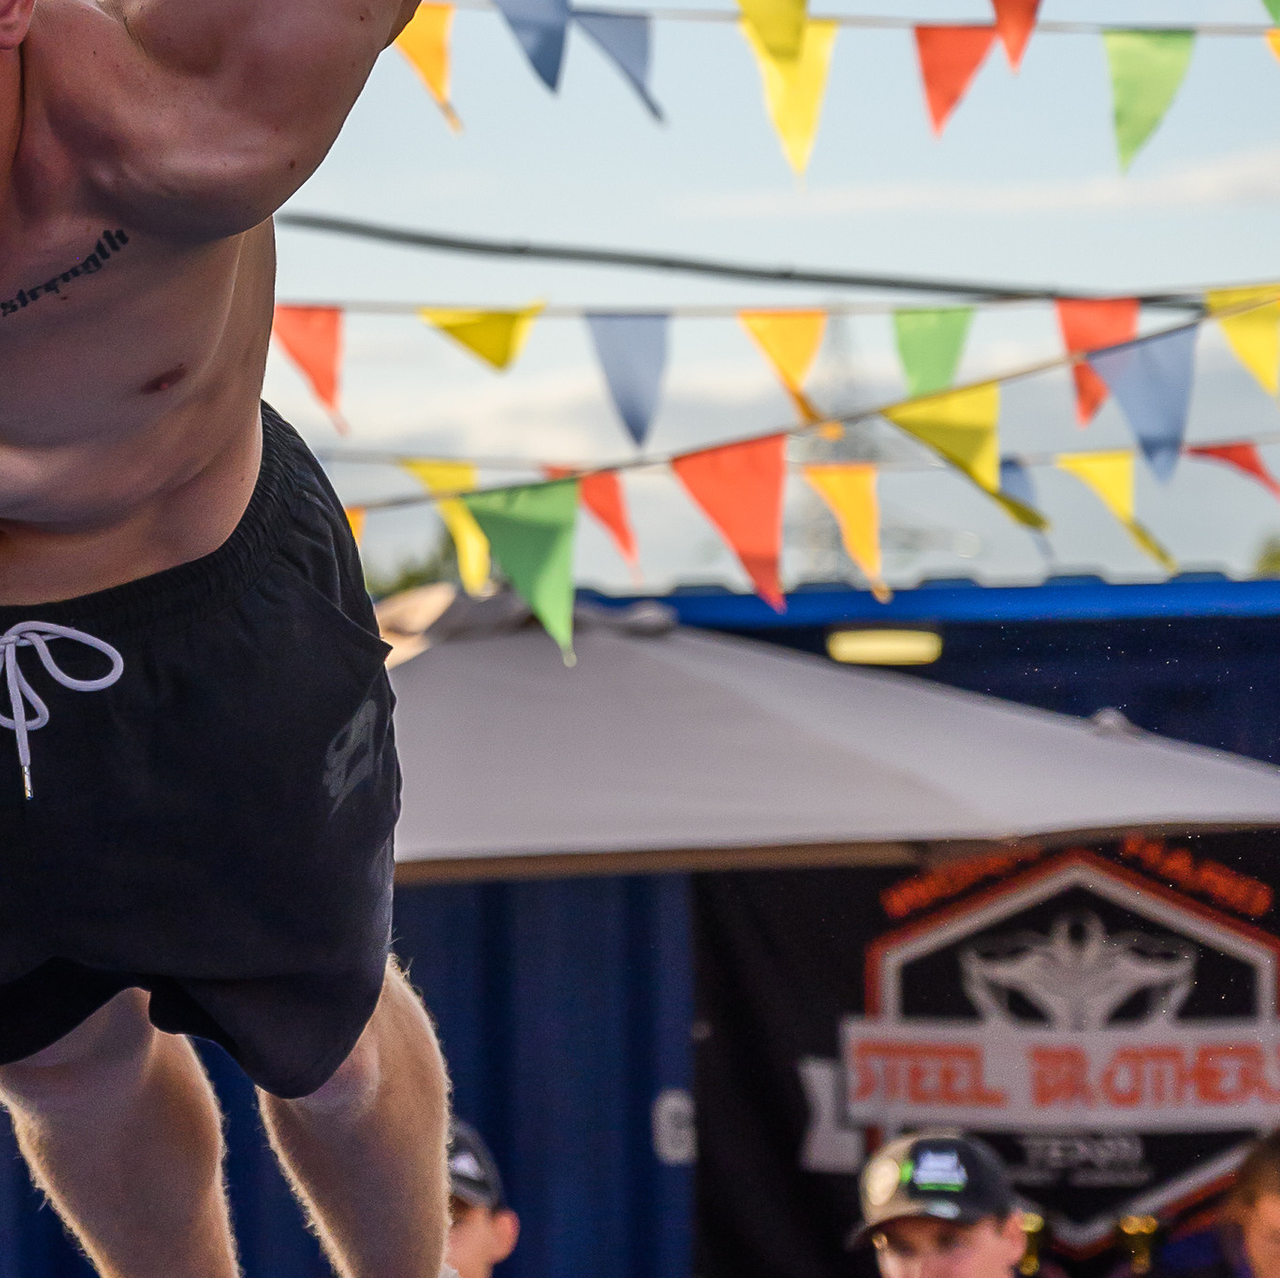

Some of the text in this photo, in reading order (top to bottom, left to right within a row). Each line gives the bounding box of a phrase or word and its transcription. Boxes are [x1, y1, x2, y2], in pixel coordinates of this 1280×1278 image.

[0, 228, 131, 318] strength
[851, 1038, 1280, 1109] STEEL BROTHER
